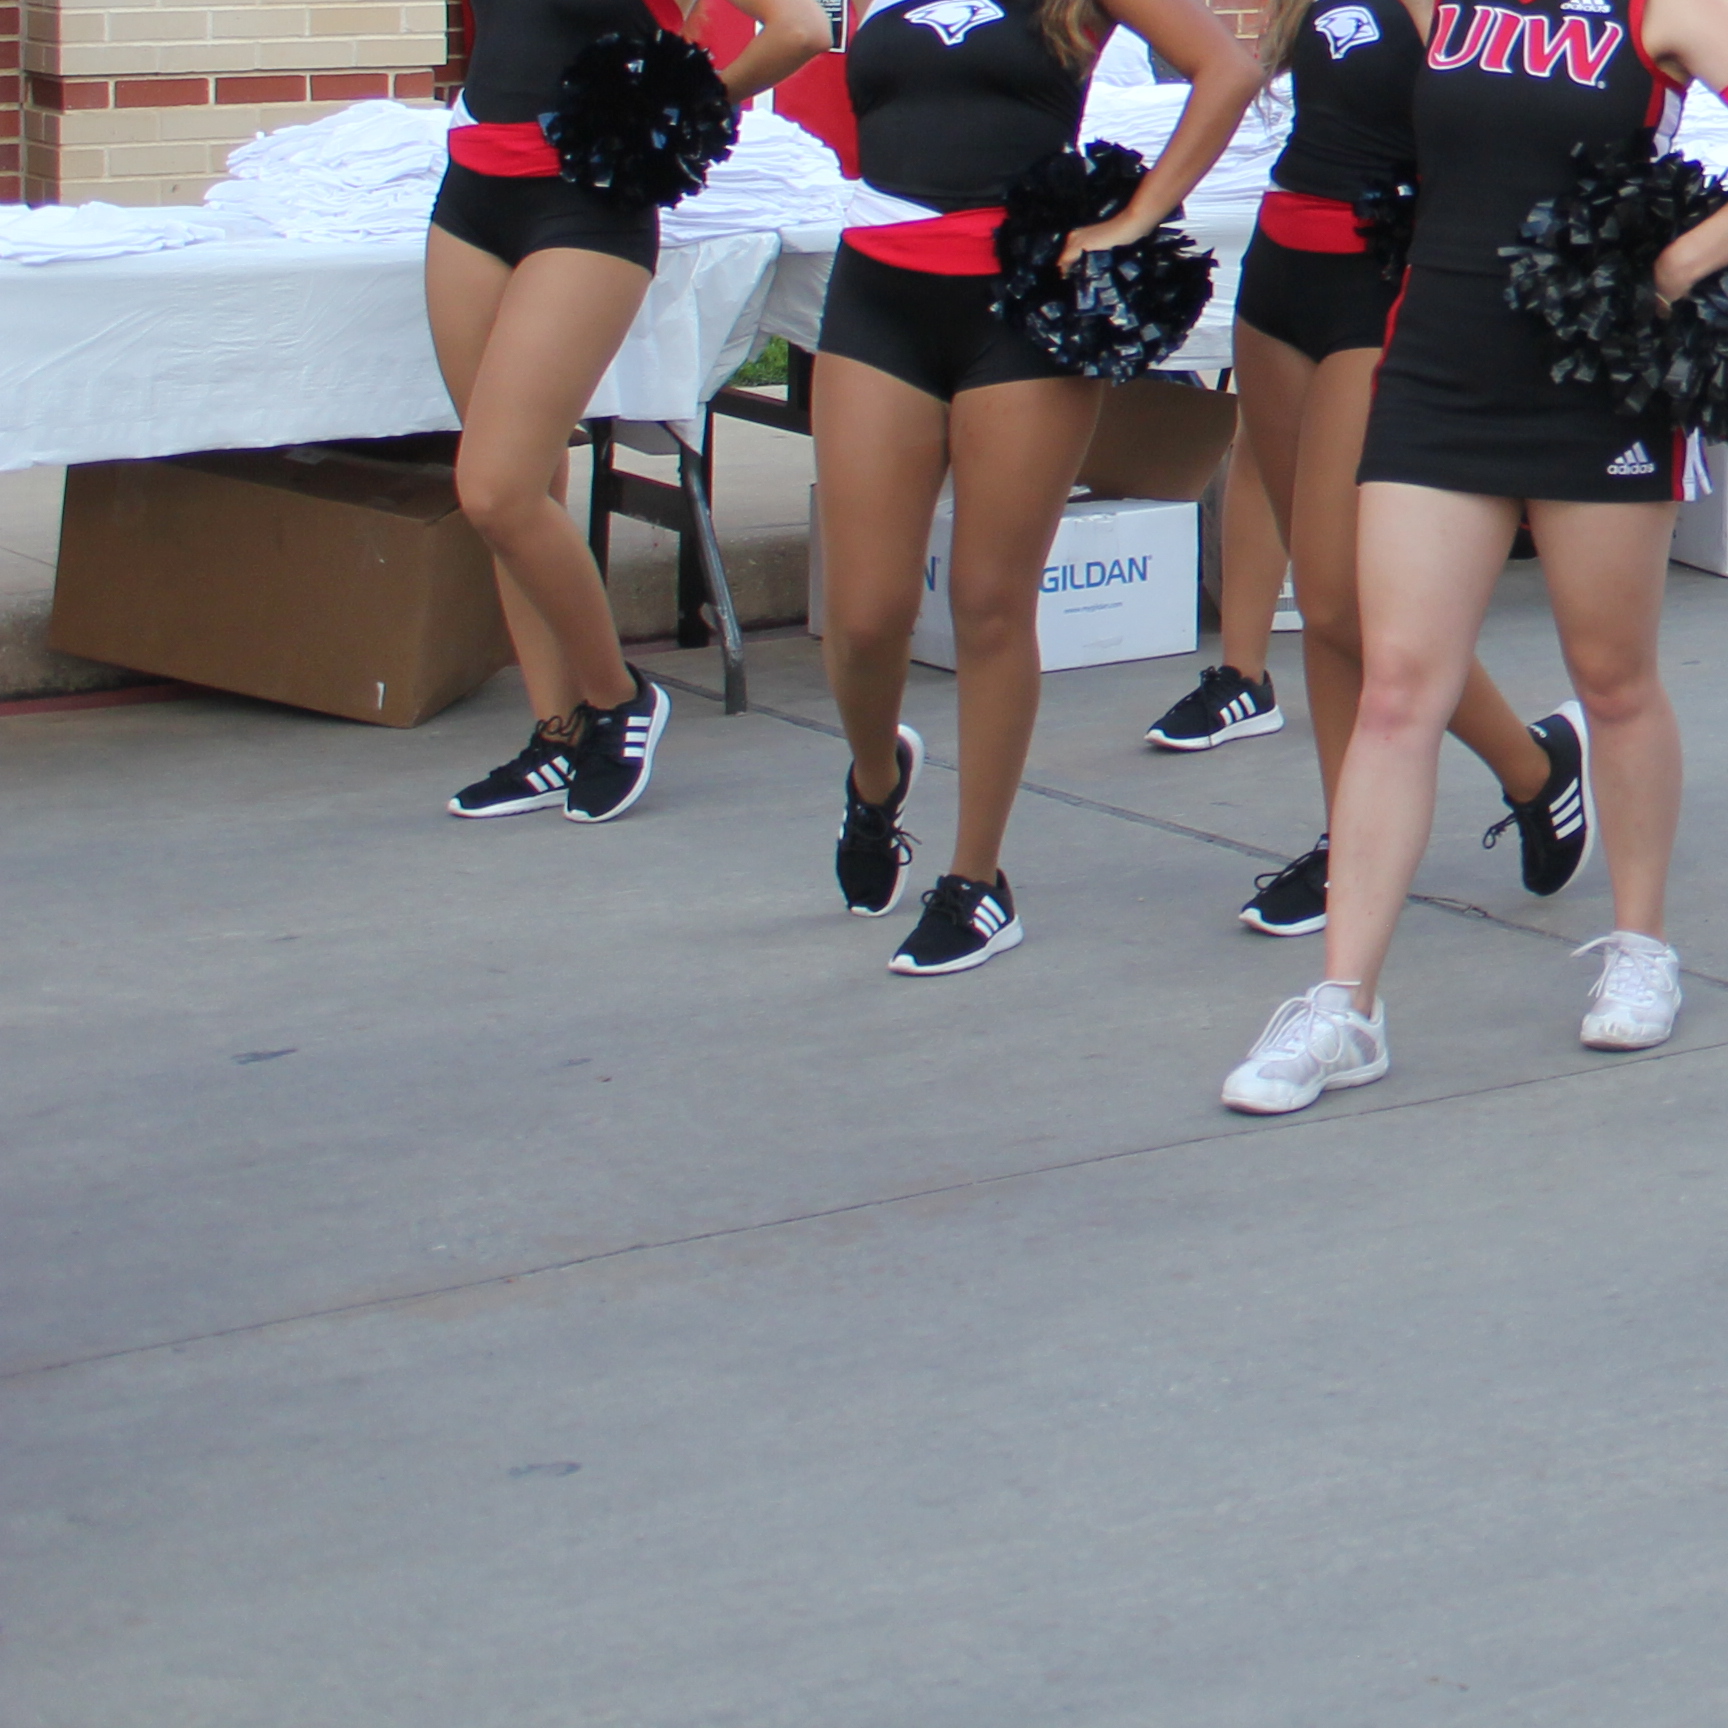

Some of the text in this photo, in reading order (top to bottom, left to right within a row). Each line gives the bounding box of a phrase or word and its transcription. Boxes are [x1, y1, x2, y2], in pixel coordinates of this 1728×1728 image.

[1428, 4, 1623, 87] UIW
[1607, 462, 1654, 475] adidas
[1039, 555, 1148, 594] GILDAN
